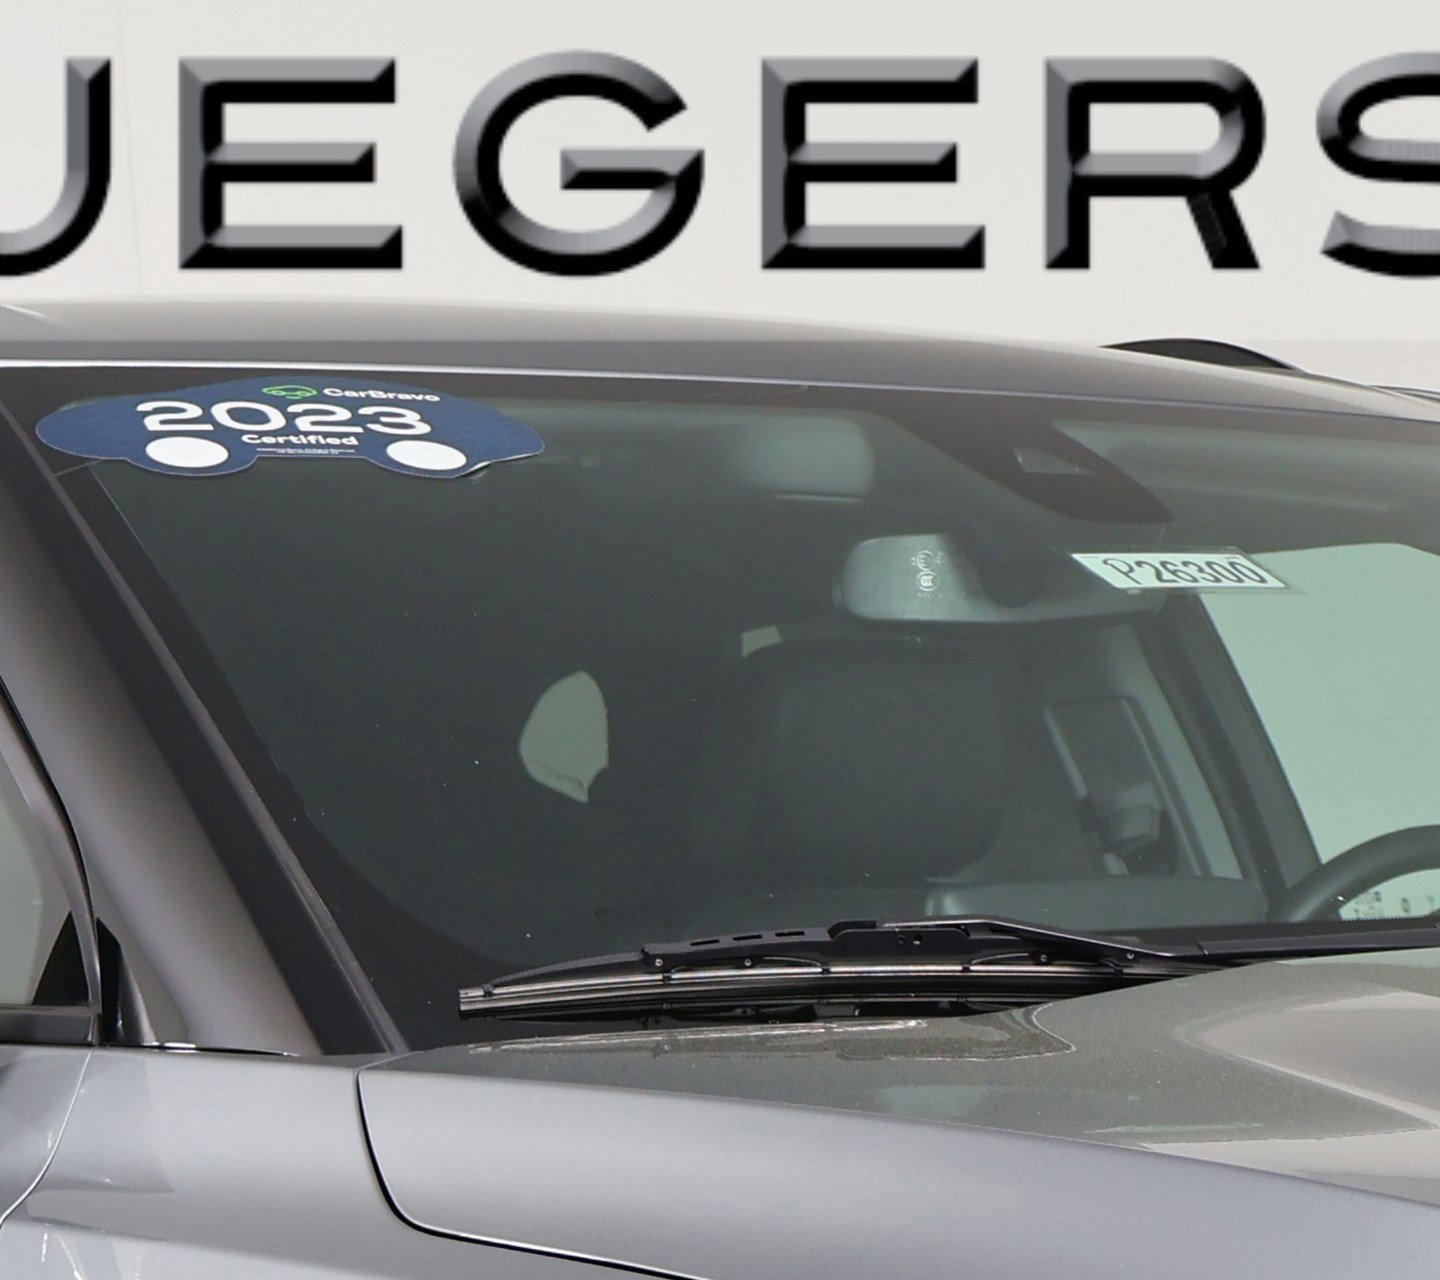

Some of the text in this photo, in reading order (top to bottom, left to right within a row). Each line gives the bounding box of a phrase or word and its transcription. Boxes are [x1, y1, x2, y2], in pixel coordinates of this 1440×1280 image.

[322, 387, 441, 402] CarBravo
[136, 400, 433, 436] 2023
[240, 434, 359, 446] Certified
[1102, 557, 1267, 586] P26300
